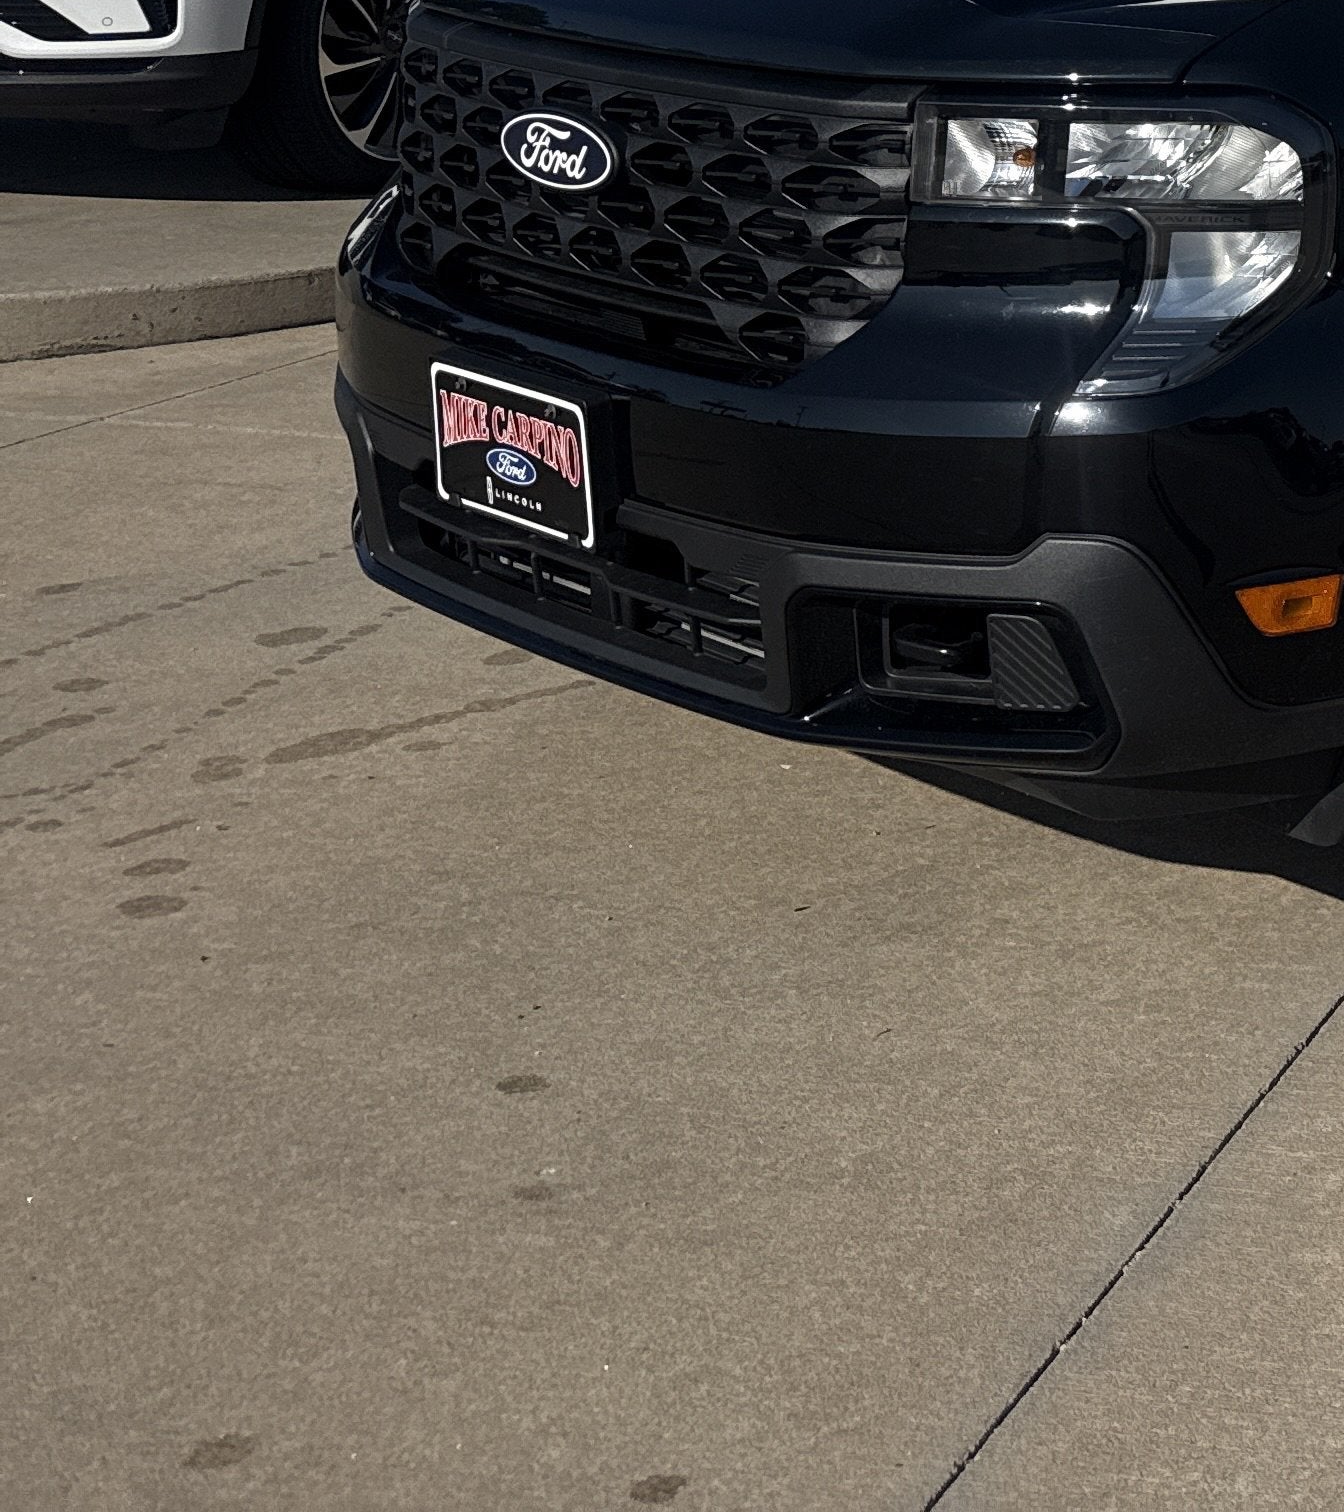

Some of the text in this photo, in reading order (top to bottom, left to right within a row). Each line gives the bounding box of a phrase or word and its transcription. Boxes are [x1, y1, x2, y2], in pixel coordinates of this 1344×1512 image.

[519, 121, 589, 180] Ford
[439, 389, 581, 488] MIKE CARPINO
[495, 452, 528, 481] Ford
[495, 487, 543, 512] LINCOLN
